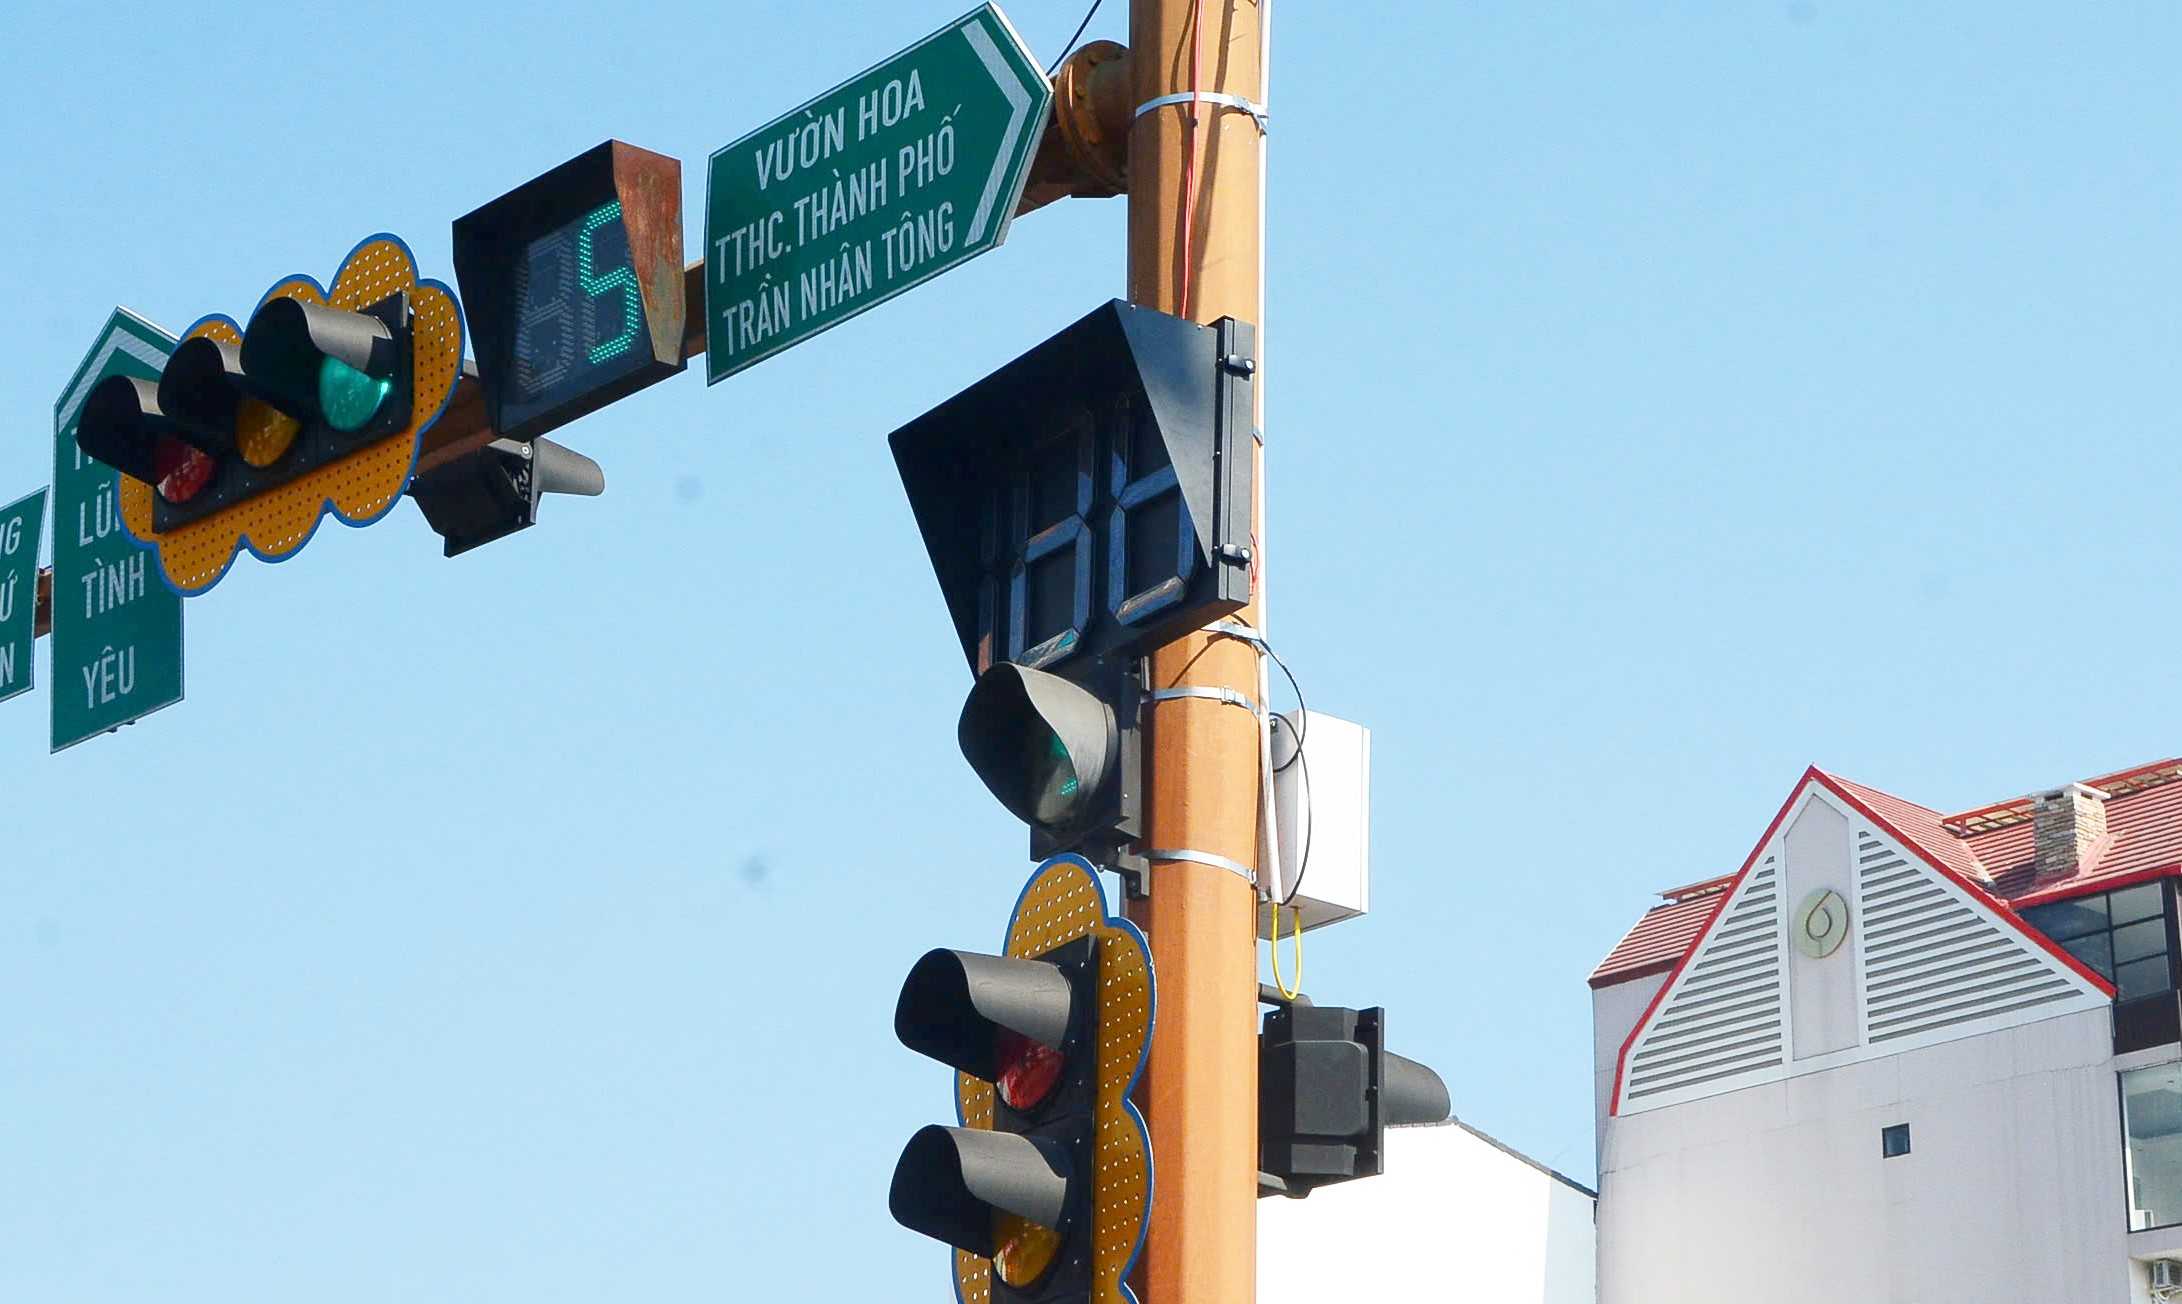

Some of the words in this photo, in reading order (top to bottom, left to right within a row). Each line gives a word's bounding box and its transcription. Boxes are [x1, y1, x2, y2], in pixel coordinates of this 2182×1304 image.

[755, 107, 845, 190] VƯỜN
[858, 69, 925, 141] HOA
[794, 158, 887, 246] THÀNH
[899, 104, 962, 197] PHỐ
[722, 273, 790, 356] TRẦN
[801, 241, 872, 321] NHÂN
[881, 201, 954, 280] TÔNG
[80, 480, 119, 546] LŨ
[81, 551, 145, 619] TÌNH
[82, 645, 135, 709] YÊU
